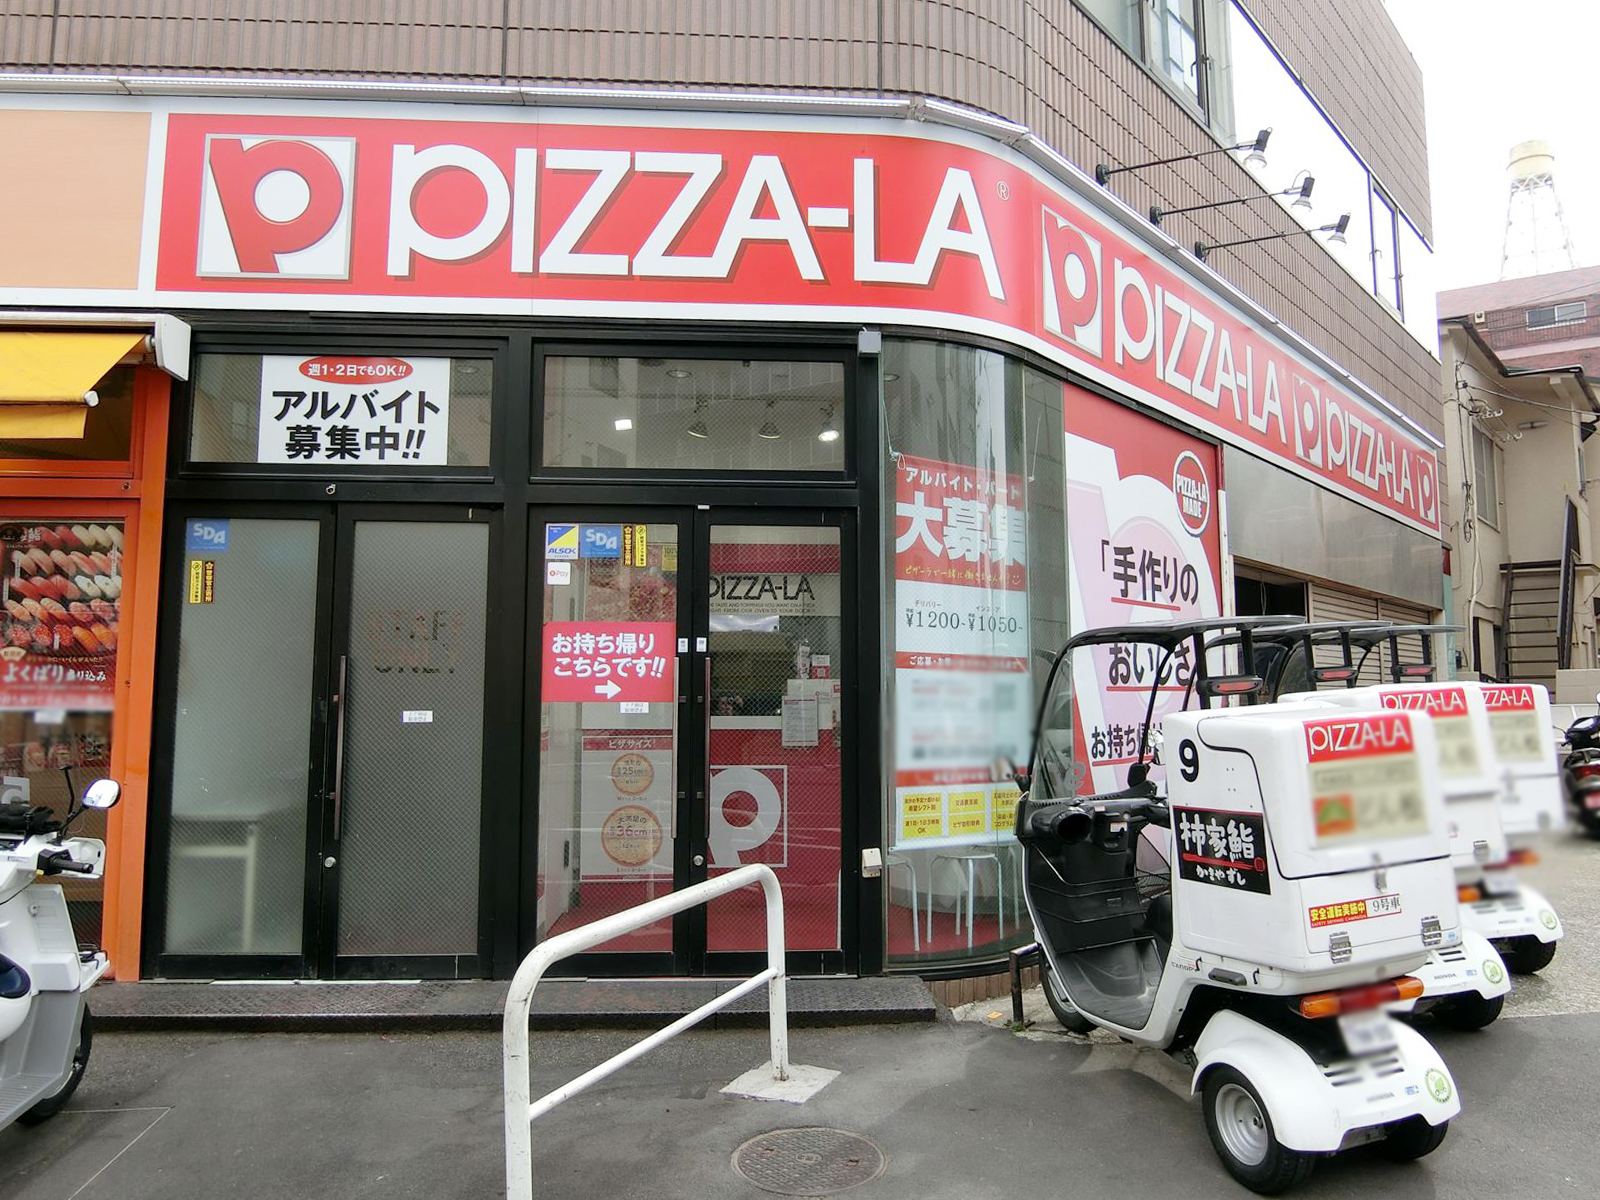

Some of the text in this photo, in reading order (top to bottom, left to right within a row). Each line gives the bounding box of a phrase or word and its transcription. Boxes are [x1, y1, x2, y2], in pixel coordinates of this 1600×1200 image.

[387, 143, 1005, 301] PIZZA-LA
[1114, 257, 1288, 445] PIZZA-LA
[272, 389, 441, 424] アルバイト
[285, 425, 427, 460] 募集中!!
[1325, 397, 1415, 511] PIZZA-LA
[1177, 474, 1207, 502] PIZZA-LA
[1182, 496, 1202, 518] MADE
[193, 523, 226, 544] SDA
[585, 528, 618, 550] SDA
[896, 491, 1025, 566] 大募集
[547, 547, 576, 555] ALSOK
[1101, 539, 1199, 605] 「手作りの
[976, 605, 1000, 613] インスア
[552, 632, 655, 655] お持ち帰り
[553, 656, 666, 678] こちらです!!
[1483, 688, 1532, 707] ZZA-LA
[1308, 718, 1410, 755] PIZZA-LA
[1179, 738, 1199, 783] 9
[1179, 812, 1255, 863] 柿家鮨
[1310, 901, 1366, 921] 安全運転実施中
